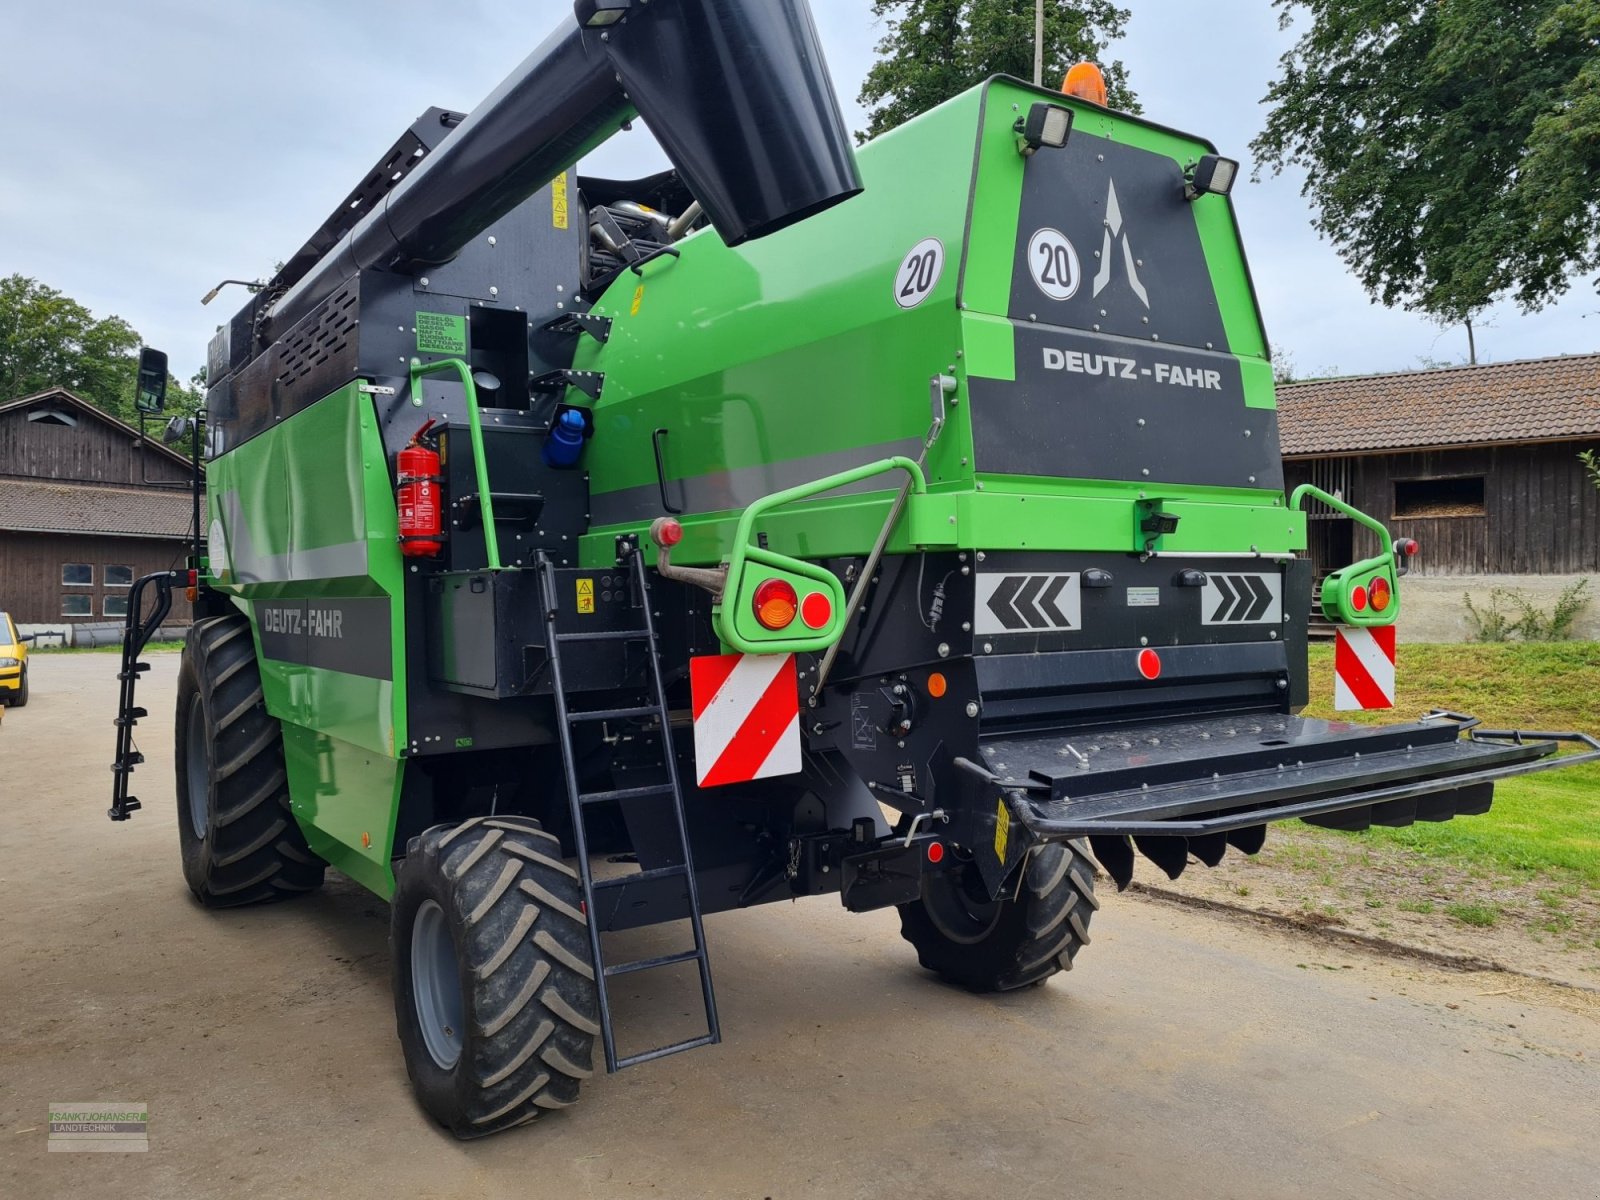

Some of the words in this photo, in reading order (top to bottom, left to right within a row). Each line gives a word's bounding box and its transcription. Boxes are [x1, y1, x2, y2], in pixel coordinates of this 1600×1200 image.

[900, 249, 937, 298] 20
[1039, 242, 1072, 288] 20
[1042, 347, 1222, 391] DEUTZ-FAHR
[264, 608, 343, 639] DEUTZ-FAHR
